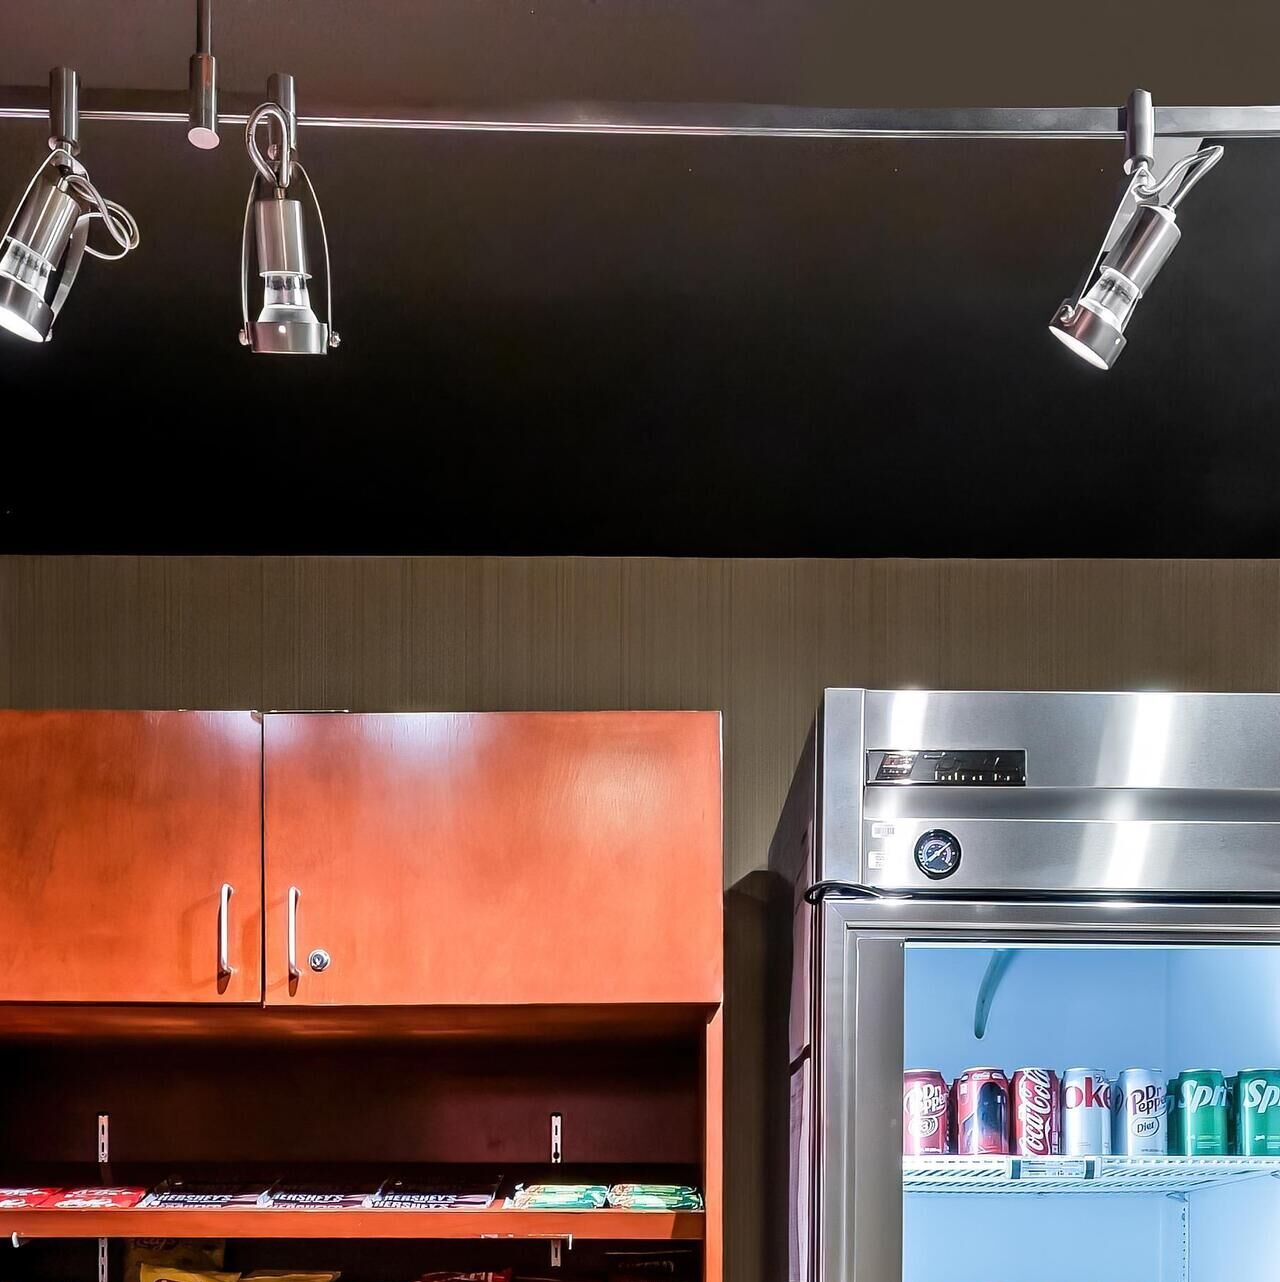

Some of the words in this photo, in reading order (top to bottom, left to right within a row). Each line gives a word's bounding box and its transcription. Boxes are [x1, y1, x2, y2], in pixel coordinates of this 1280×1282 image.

[1146, 1085, 1165, 1101] Dr
[1137, 1120, 1155, 1134] Diet
[158, 1194, 233, 1203] HERSHEY'S
[384, 1195, 457, 1204] HERSHEY'S
